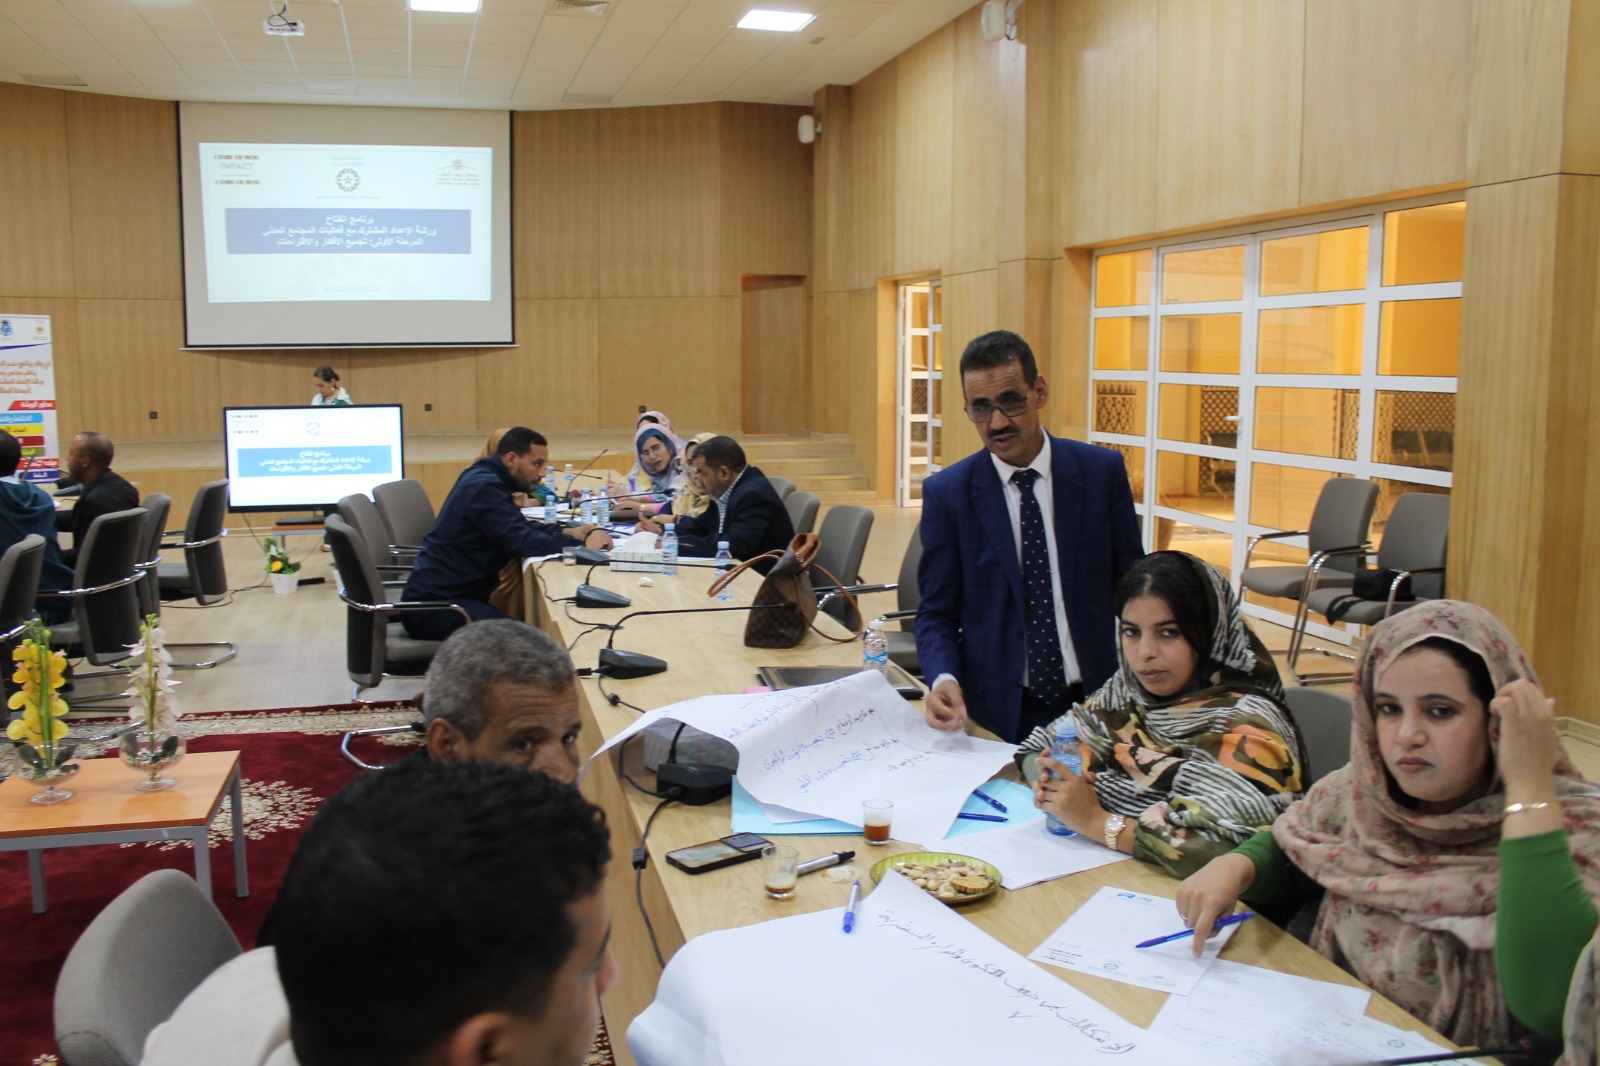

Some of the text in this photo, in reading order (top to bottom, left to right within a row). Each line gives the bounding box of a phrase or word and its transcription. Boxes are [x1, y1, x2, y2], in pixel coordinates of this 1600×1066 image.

[220, 162, 254, 170] IMPACT
[349, 215, 374, 226] برنامج
[262, 226, 285, 237] المدني
[288, 226, 316, 237] المجتمع
[345, 228, 356, 237] مع
[358, 225, 388, 236] المشترك
[415, 225, 437, 236] ورشة
[345, 237, 368, 248] تجميع
[396, 236, 423, 247] المرحلة
